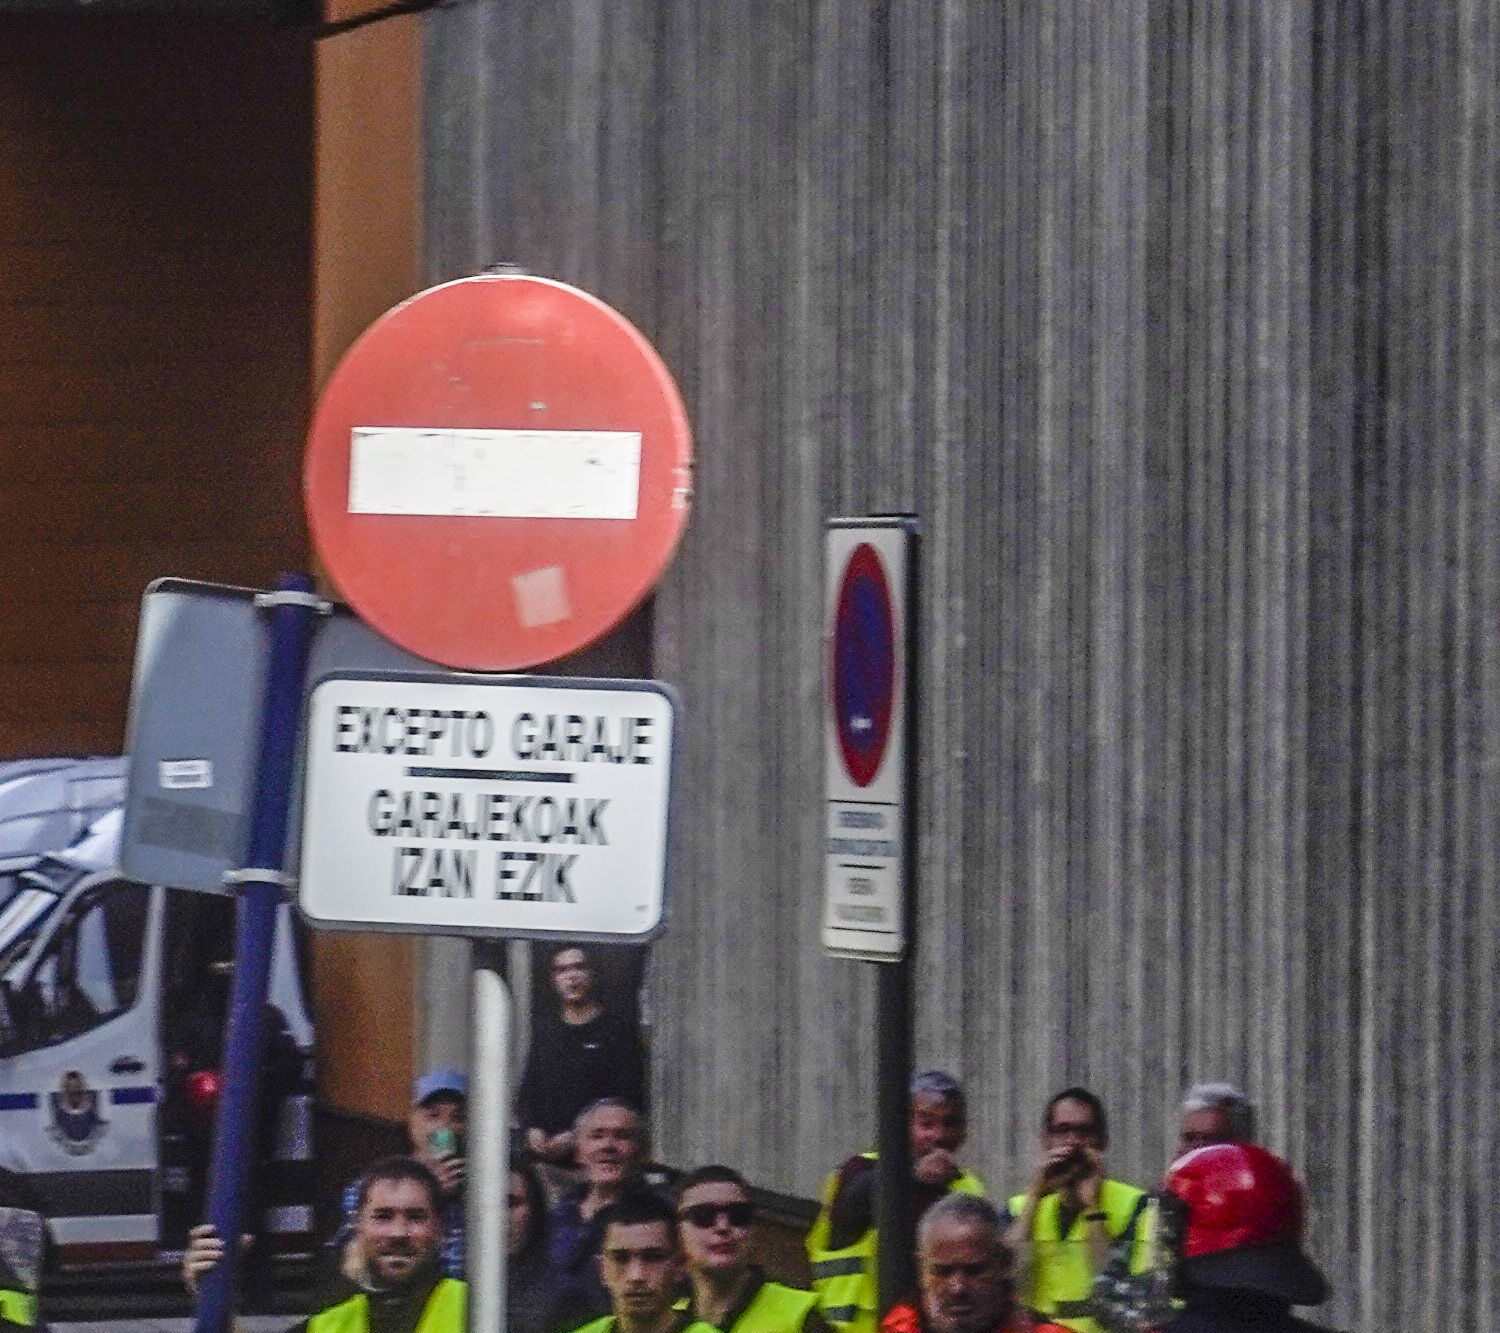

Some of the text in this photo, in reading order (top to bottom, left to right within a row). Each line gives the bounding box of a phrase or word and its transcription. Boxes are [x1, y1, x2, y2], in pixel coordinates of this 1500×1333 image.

[334, 705, 654, 765] EXCEPTO GARAJE
[367, 788, 610, 846] GARAJEKOAK
[392, 846, 579, 903] IZAN EZIK
